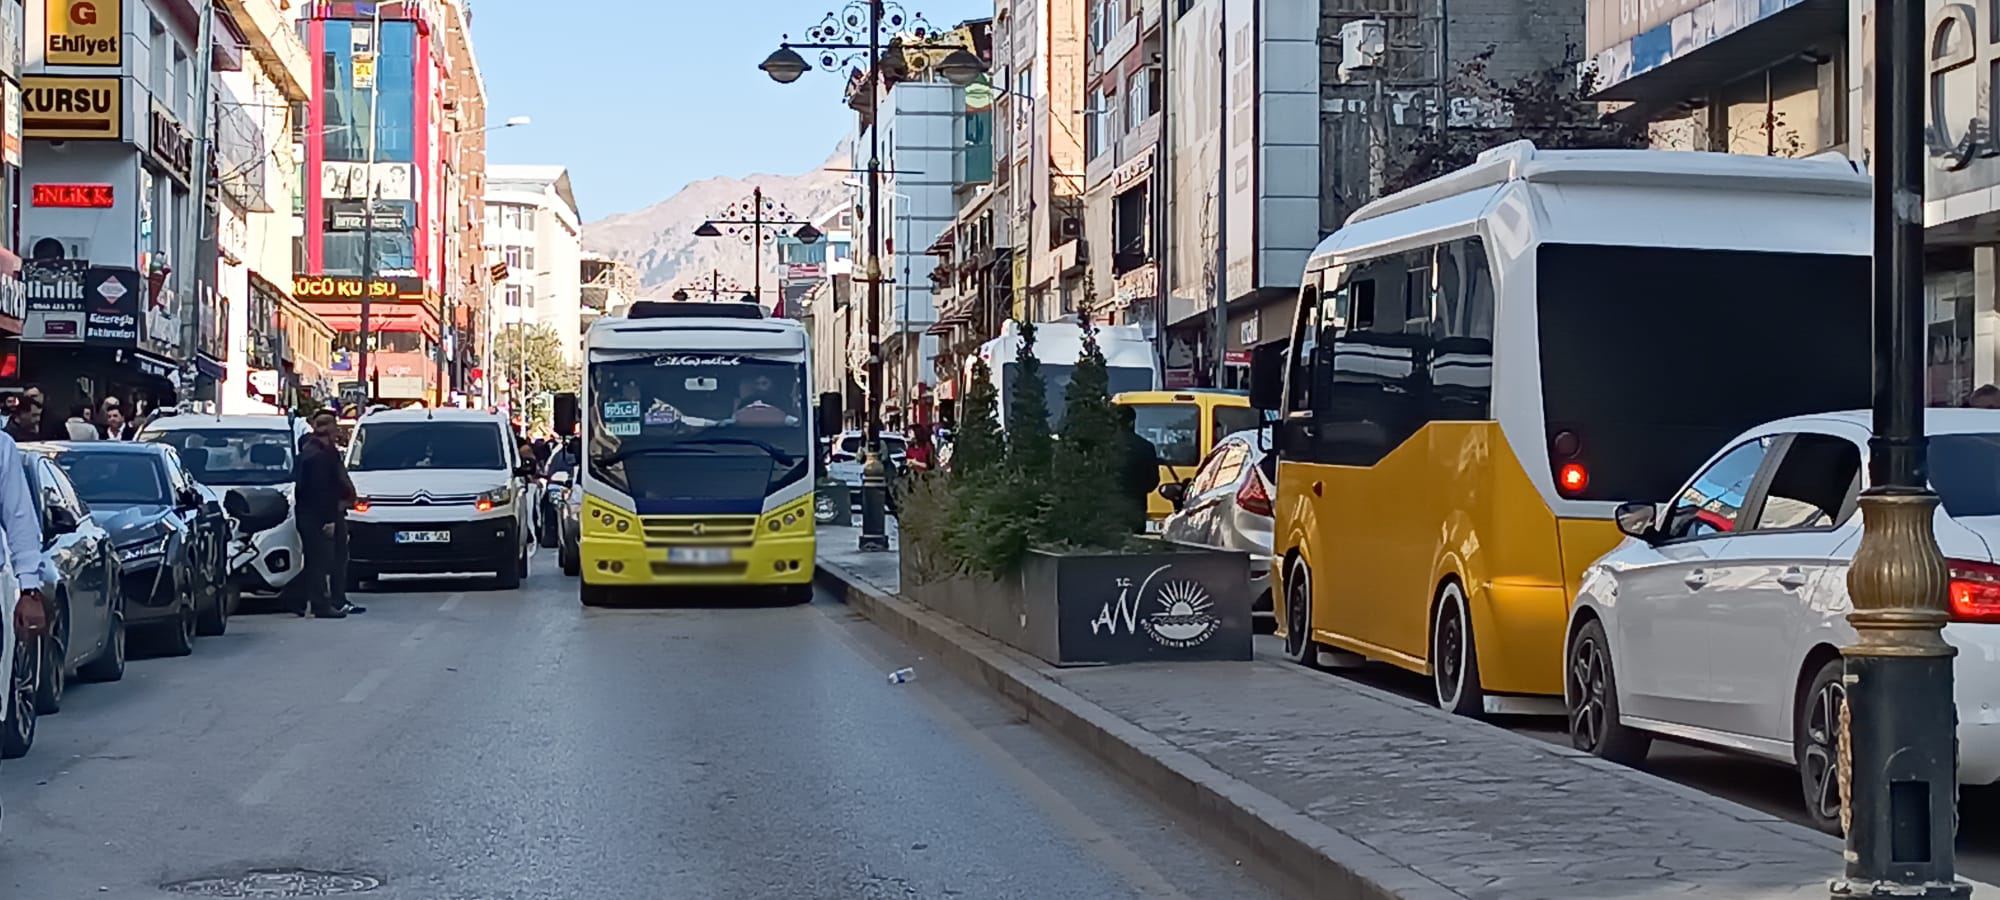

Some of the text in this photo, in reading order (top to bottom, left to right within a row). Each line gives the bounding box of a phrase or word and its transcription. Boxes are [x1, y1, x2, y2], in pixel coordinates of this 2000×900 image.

[70, 2, 97, 25] G
[50, 34, 117, 56] Ehliyet
[23, 88, 111, 112] KURSU
[27, 280, 84, 299] linlik
